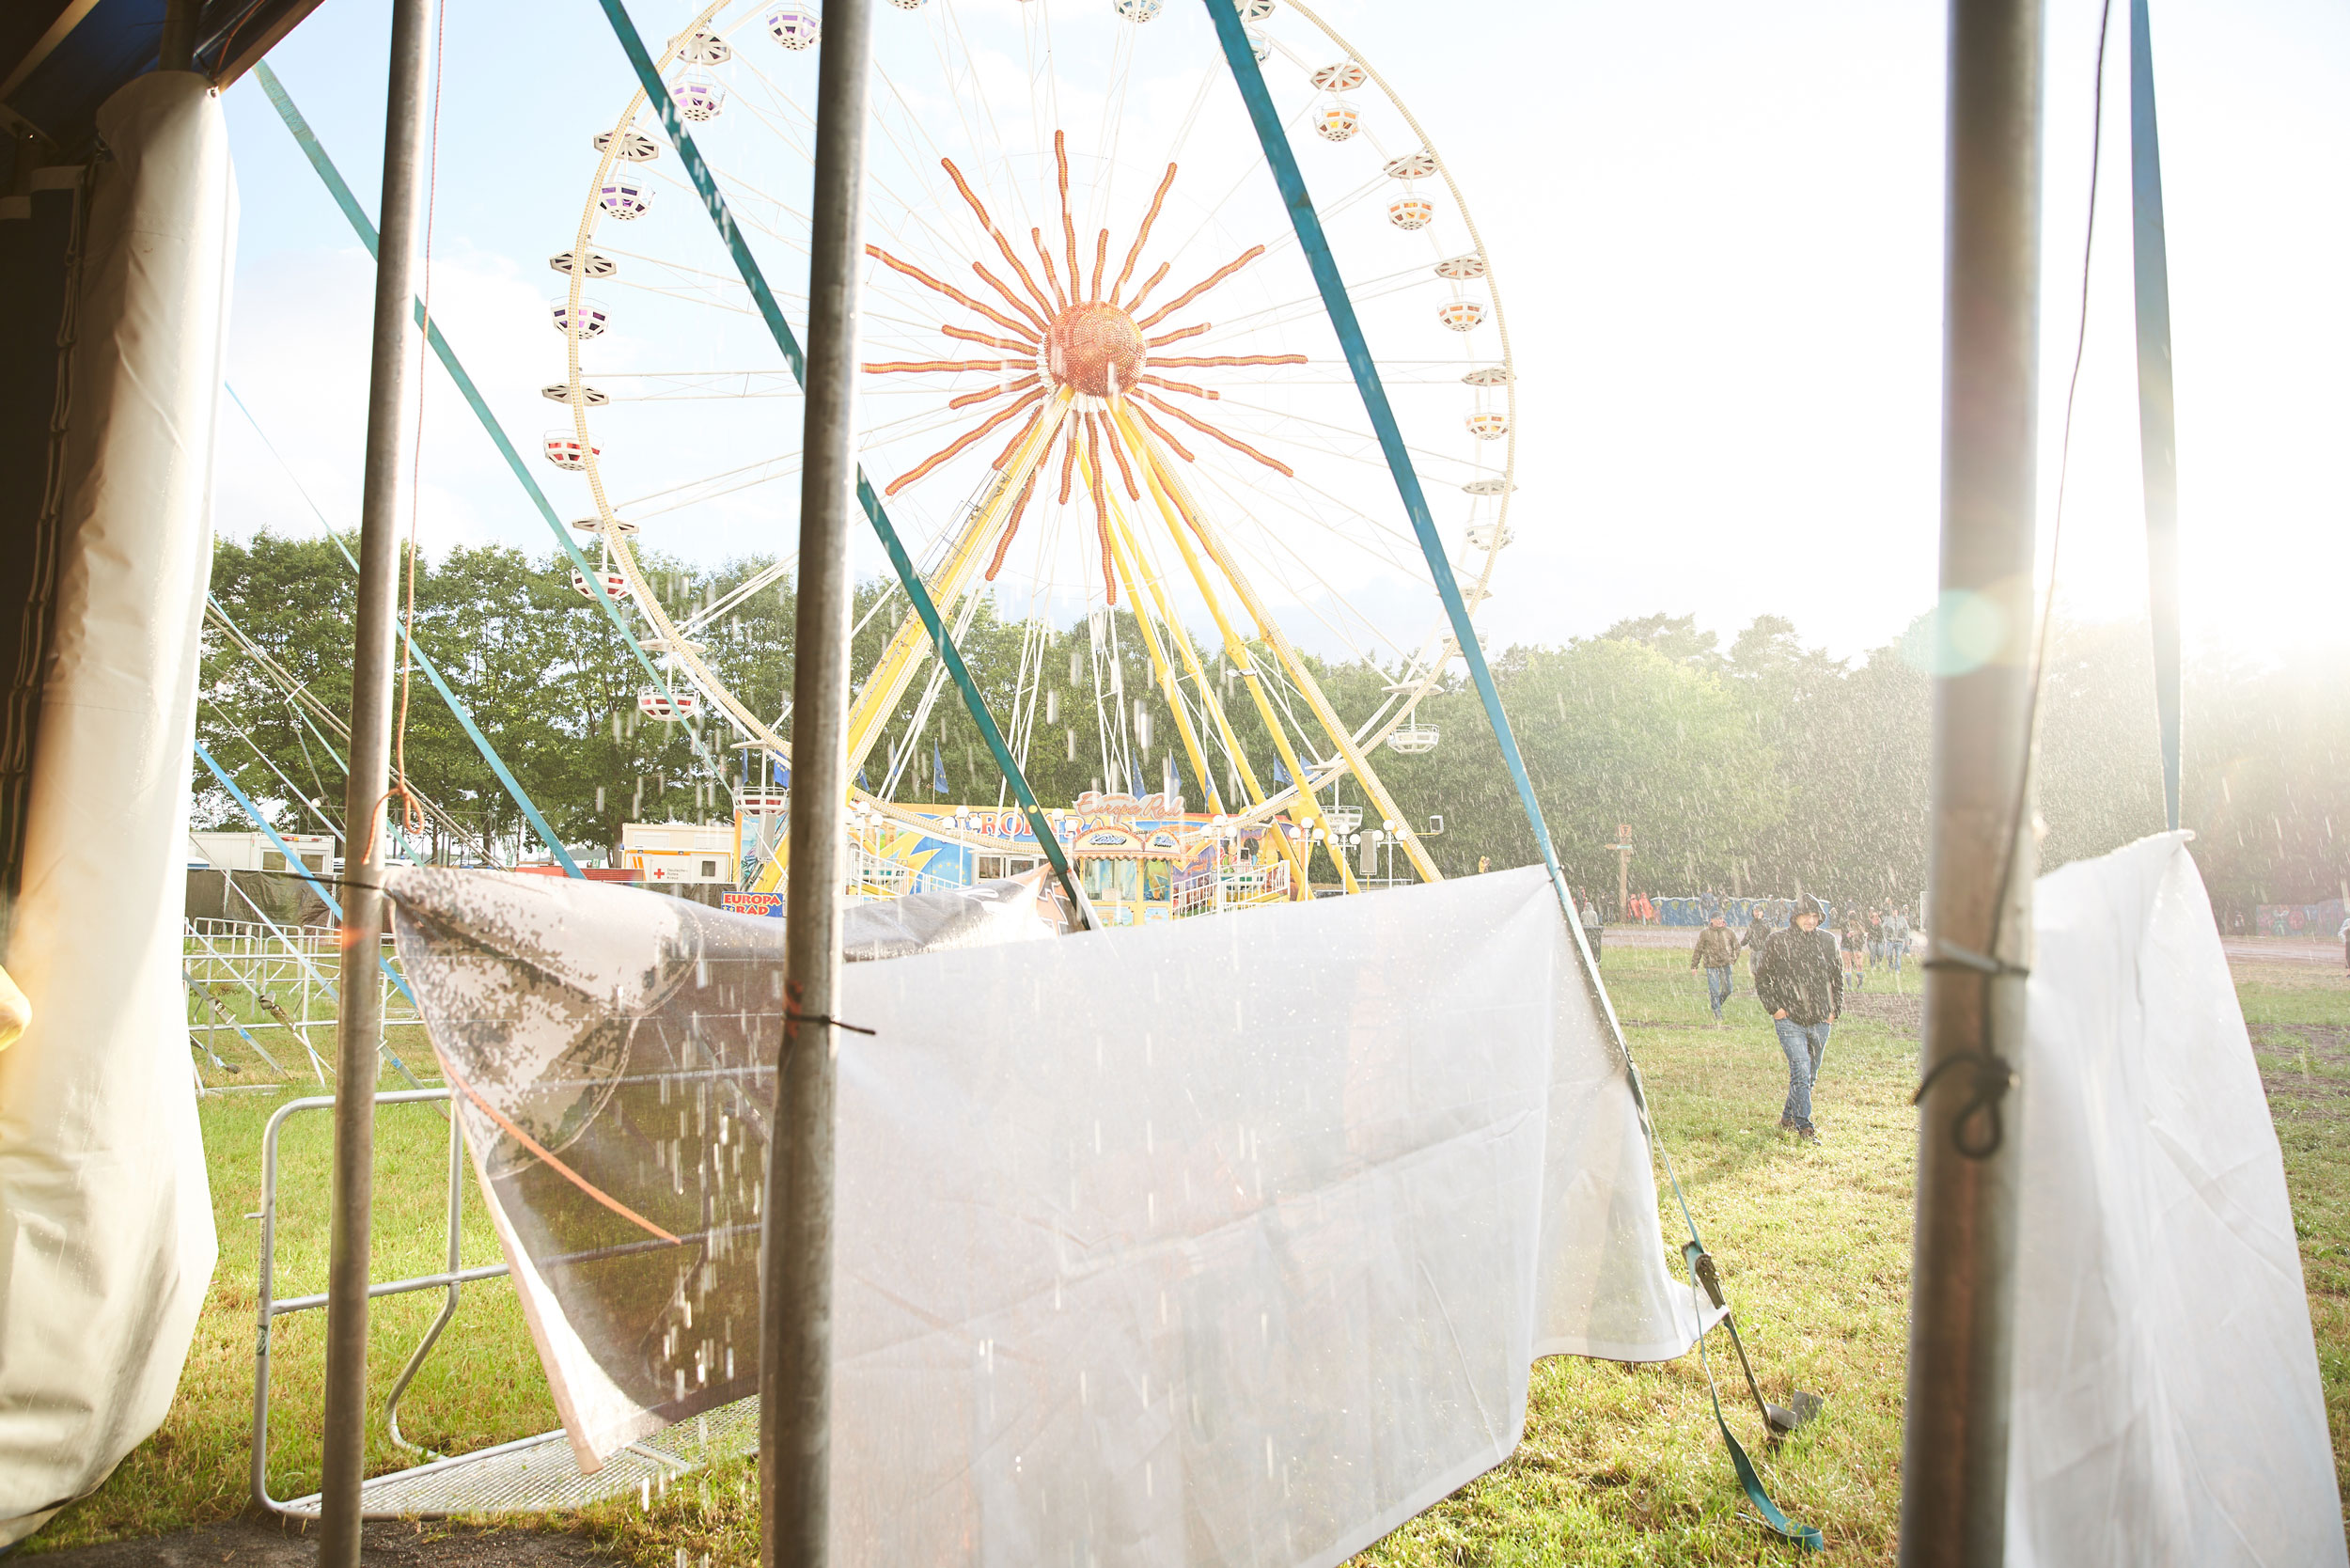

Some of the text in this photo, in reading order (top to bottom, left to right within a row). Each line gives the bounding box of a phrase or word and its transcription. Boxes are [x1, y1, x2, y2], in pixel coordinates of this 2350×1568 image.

[1076, 792, 1182, 823] Europa Rad
[724, 894, 782, 905] EUROPA
[736, 905, 769, 916] RAD
